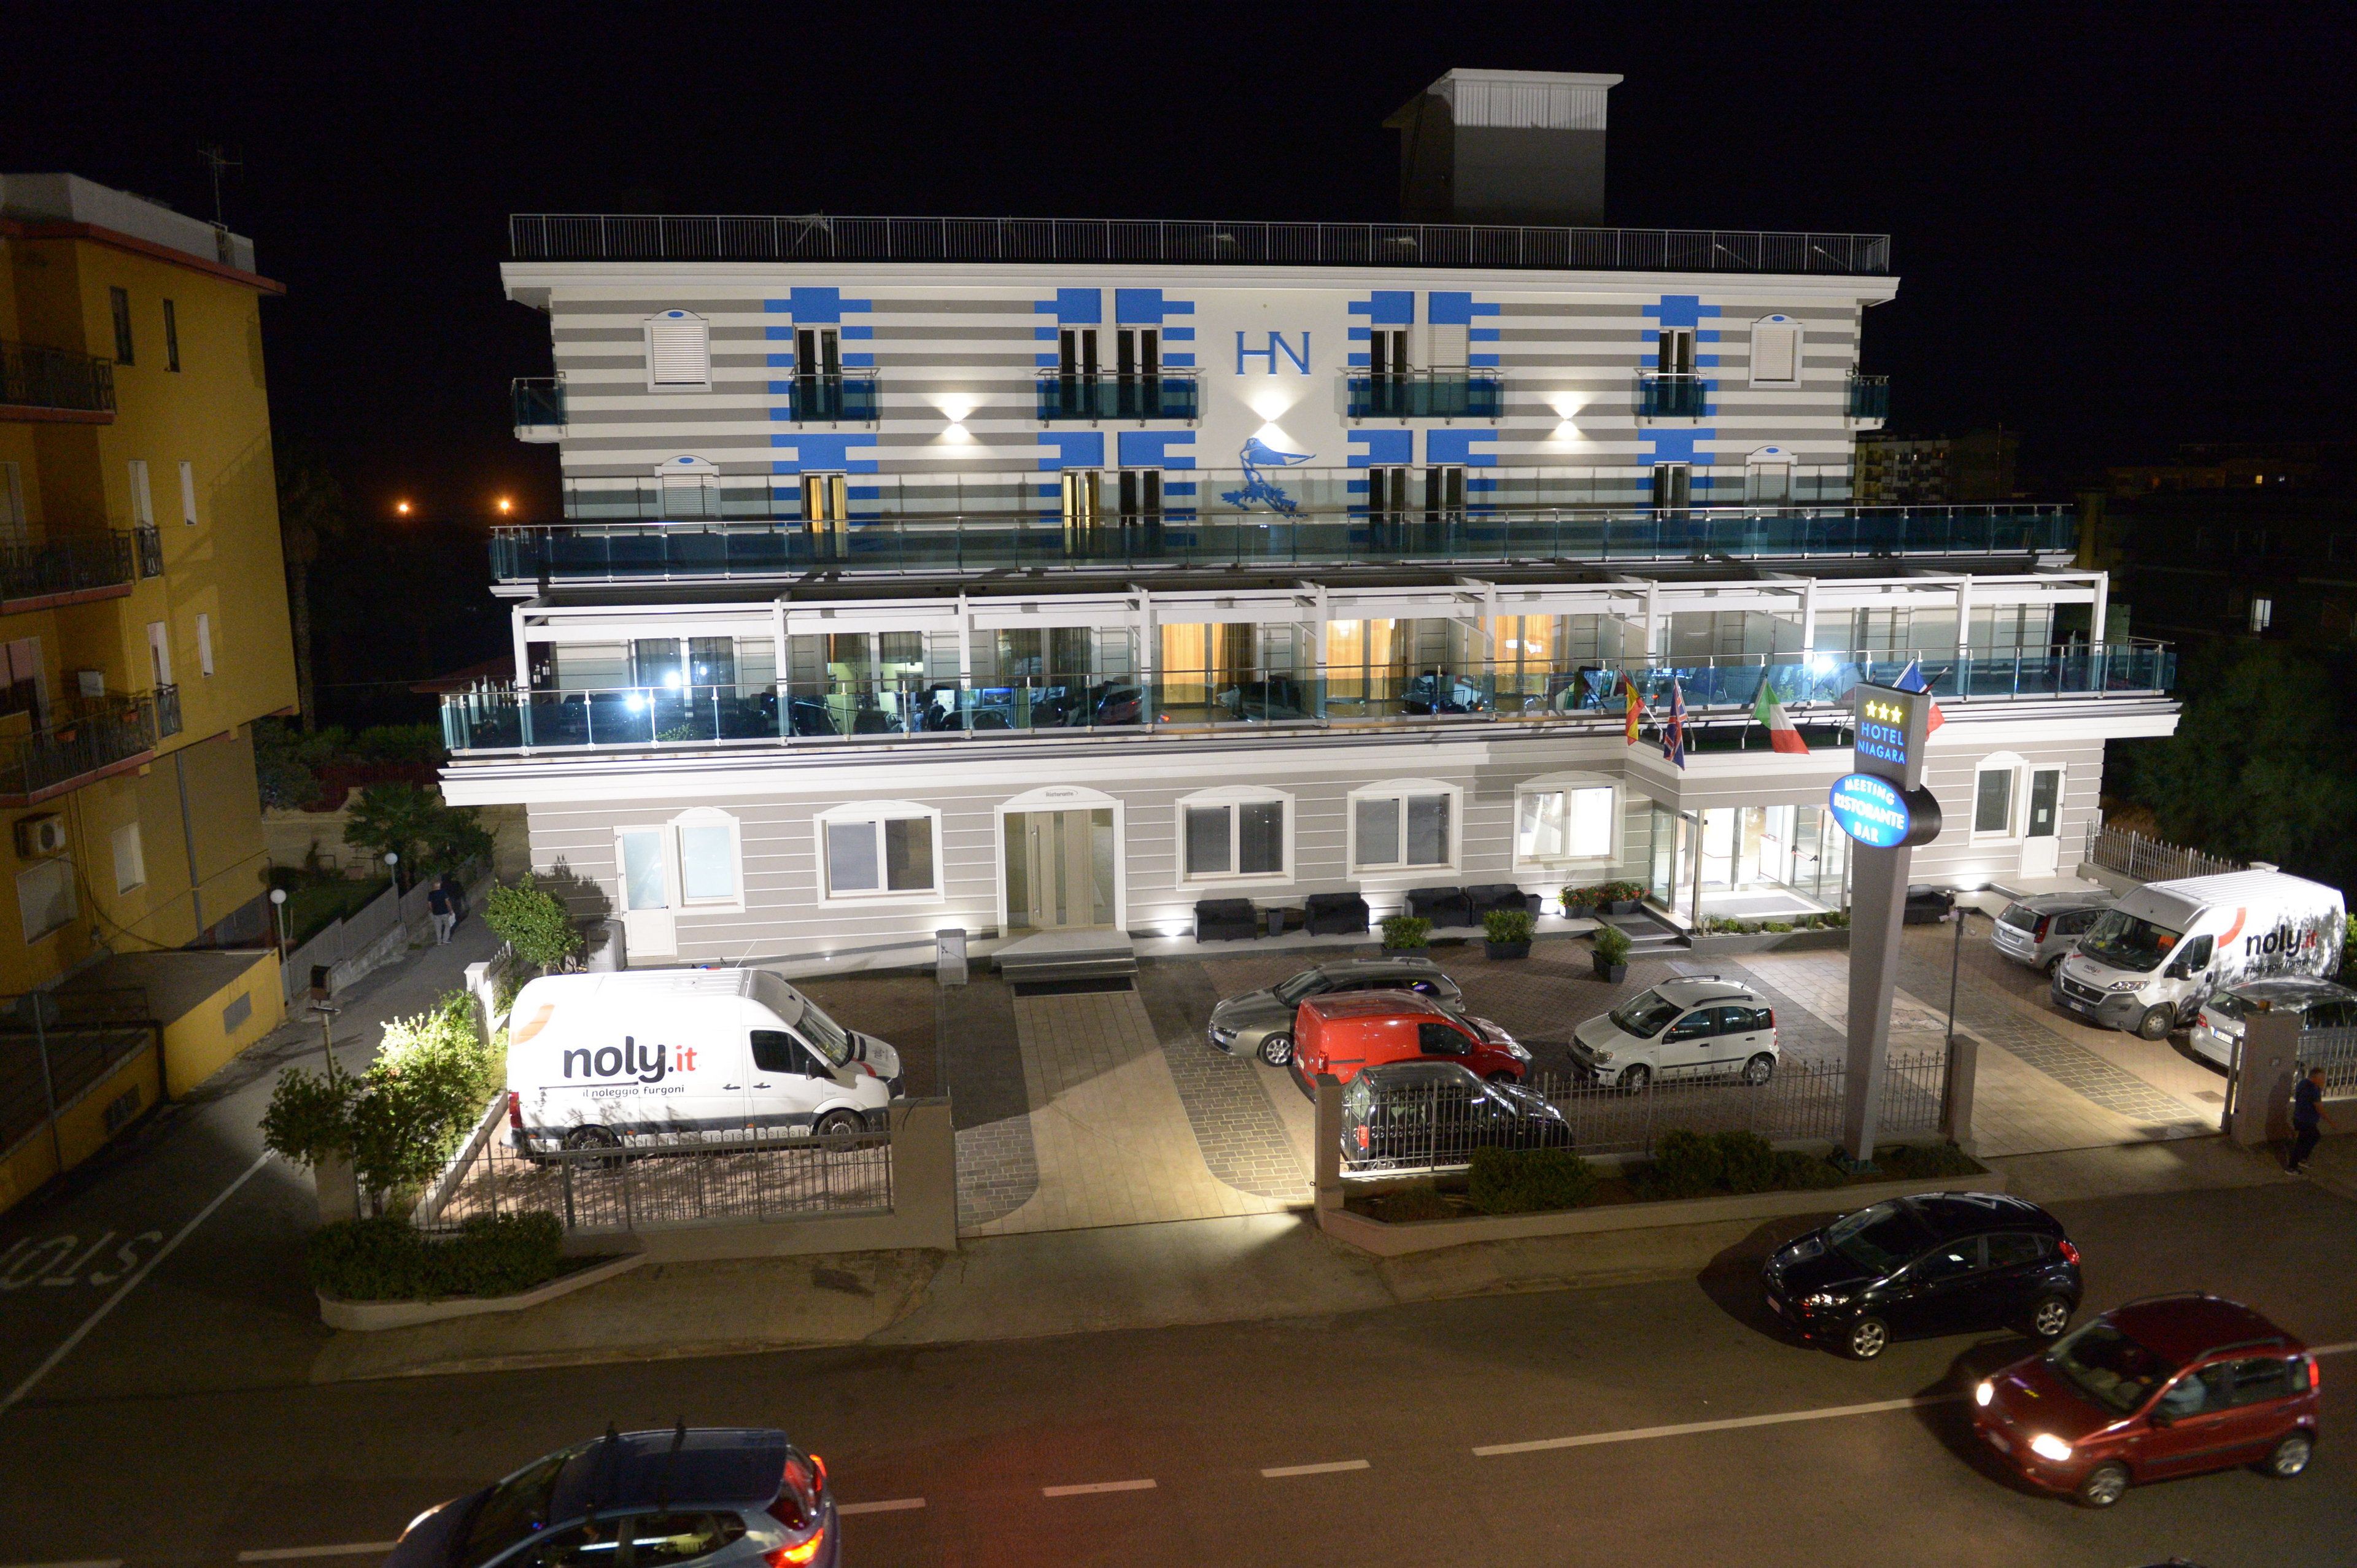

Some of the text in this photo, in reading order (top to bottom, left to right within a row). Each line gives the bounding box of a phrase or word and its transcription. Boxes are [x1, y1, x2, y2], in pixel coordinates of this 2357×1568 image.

[1235, 331, 1311, 376] HN
[1860, 722, 1904, 746] HOTEL
[1857, 740, 1906, 765] NIAGARA
[1844, 779, 1895, 806] MEETING
[1833, 792, 1905, 830] RISTORANTE
[1853, 821, 1879, 843] BAR
[2245, 924, 2318, 957] noly.it
[563, 1035, 697, 1083] noly.it
[592, 1087, 639, 1098] noleggio
[643, 1084, 684, 1095] furgoni
